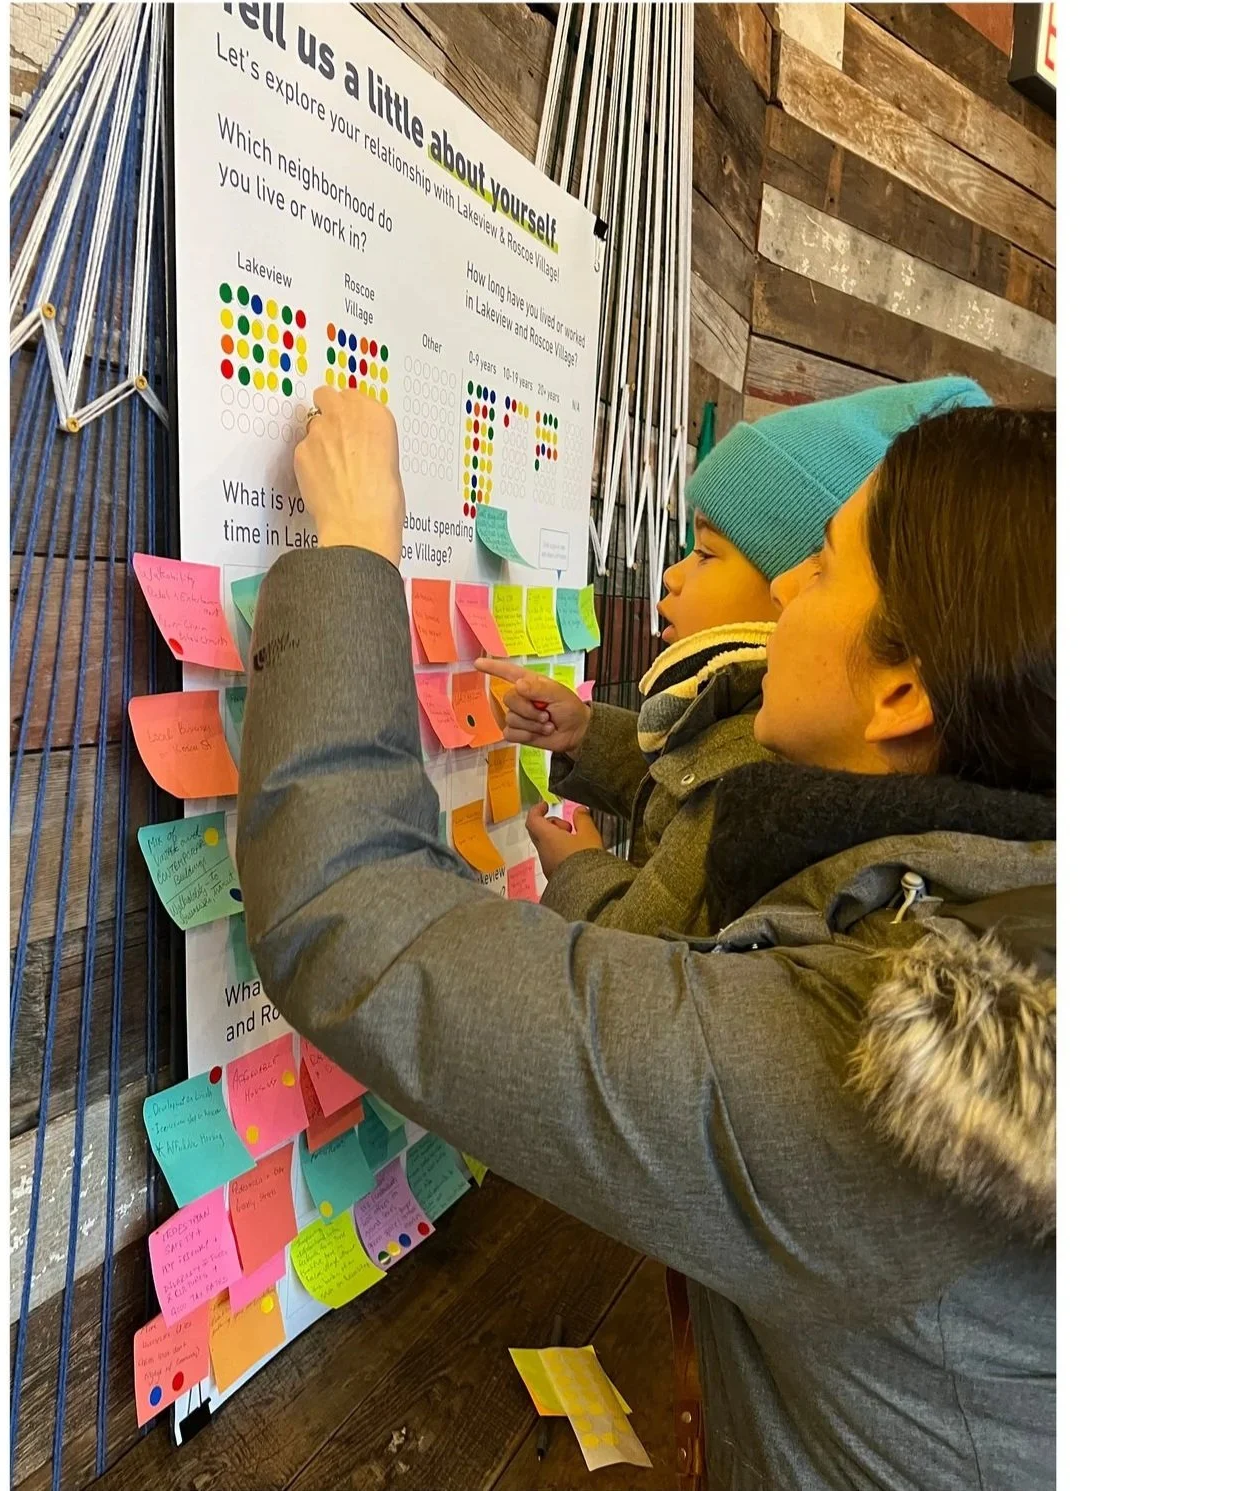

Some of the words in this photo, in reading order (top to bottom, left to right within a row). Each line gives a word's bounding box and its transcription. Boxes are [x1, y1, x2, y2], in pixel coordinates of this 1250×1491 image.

[223, 3, 286, 50] ell
[298, 26, 335, 80] us
[344, 61, 359, 101] a
[368, 66, 424, 148] little
[430, 128, 486, 196] about
[490, 177, 557, 248] yourself
[217, 32, 259, 80] Let's
[266, 71, 325, 121] explore
[330, 110, 360, 143] your
[364, 133, 432, 195] relationship
[434, 182, 454, 209] with
[457, 194, 498, 239] Lakeview
[499, 226, 505, 245] &
[508, 231, 534, 265] Roscoe
[535, 250, 560, 283] Village!
[218, 113, 272, 166] Which
[278, 153, 375, 222] neighborhood
[378, 209, 393, 232] do
[219, 162, 250, 194] you
[257, 175, 285, 210] live
[290, 200, 306, 220] or
[311, 209, 345, 242] work
[349, 224, 367, 252] in?
[237, 251, 293, 288] Lakeview
[344, 273, 375, 301] Roscoe
[344, 297, 374, 326] Village
[466, 260, 485, 287] How
[487, 274, 504, 303] long
[506, 285, 524, 311] have
[526, 301, 538, 318] you
[540, 307, 556, 328] lived
[556, 321, 564, 333] or
[565, 327, 586, 349] worked
[422, 333, 442, 354] Other
[465, 290, 474, 309] in
[475, 296, 513, 331] Lakeview
[514, 321, 528, 340] and
[529, 326, 553, 354] Roscoe
[554, 346, 579, 368] Village?
[468, 350, 480, 365] 0-9
[480, 359, 497, 375] years
[502, 366, 519, 385] 10-19
[519, 377, 533, 391] years
[537, 383, 547, 397] 20+
[547, 389, 560, 404] years
[223, 479, 265, 508] What
[271, 487, 284, 510] is
[288, 495, 305, 516] yo
[404, 512, 431, 533] about
[433, 520, 474, 542] spending
[224, 519, 260, 544] time
[266, 523, 279, 546] in
[285, 525, 318, 548] Lake
[415, 542, 452, 566] Village?
[480, 865, 505, 886] keview
[225, 980, 260, 1007] Wha
[226, 1016, 255, 1042] and
